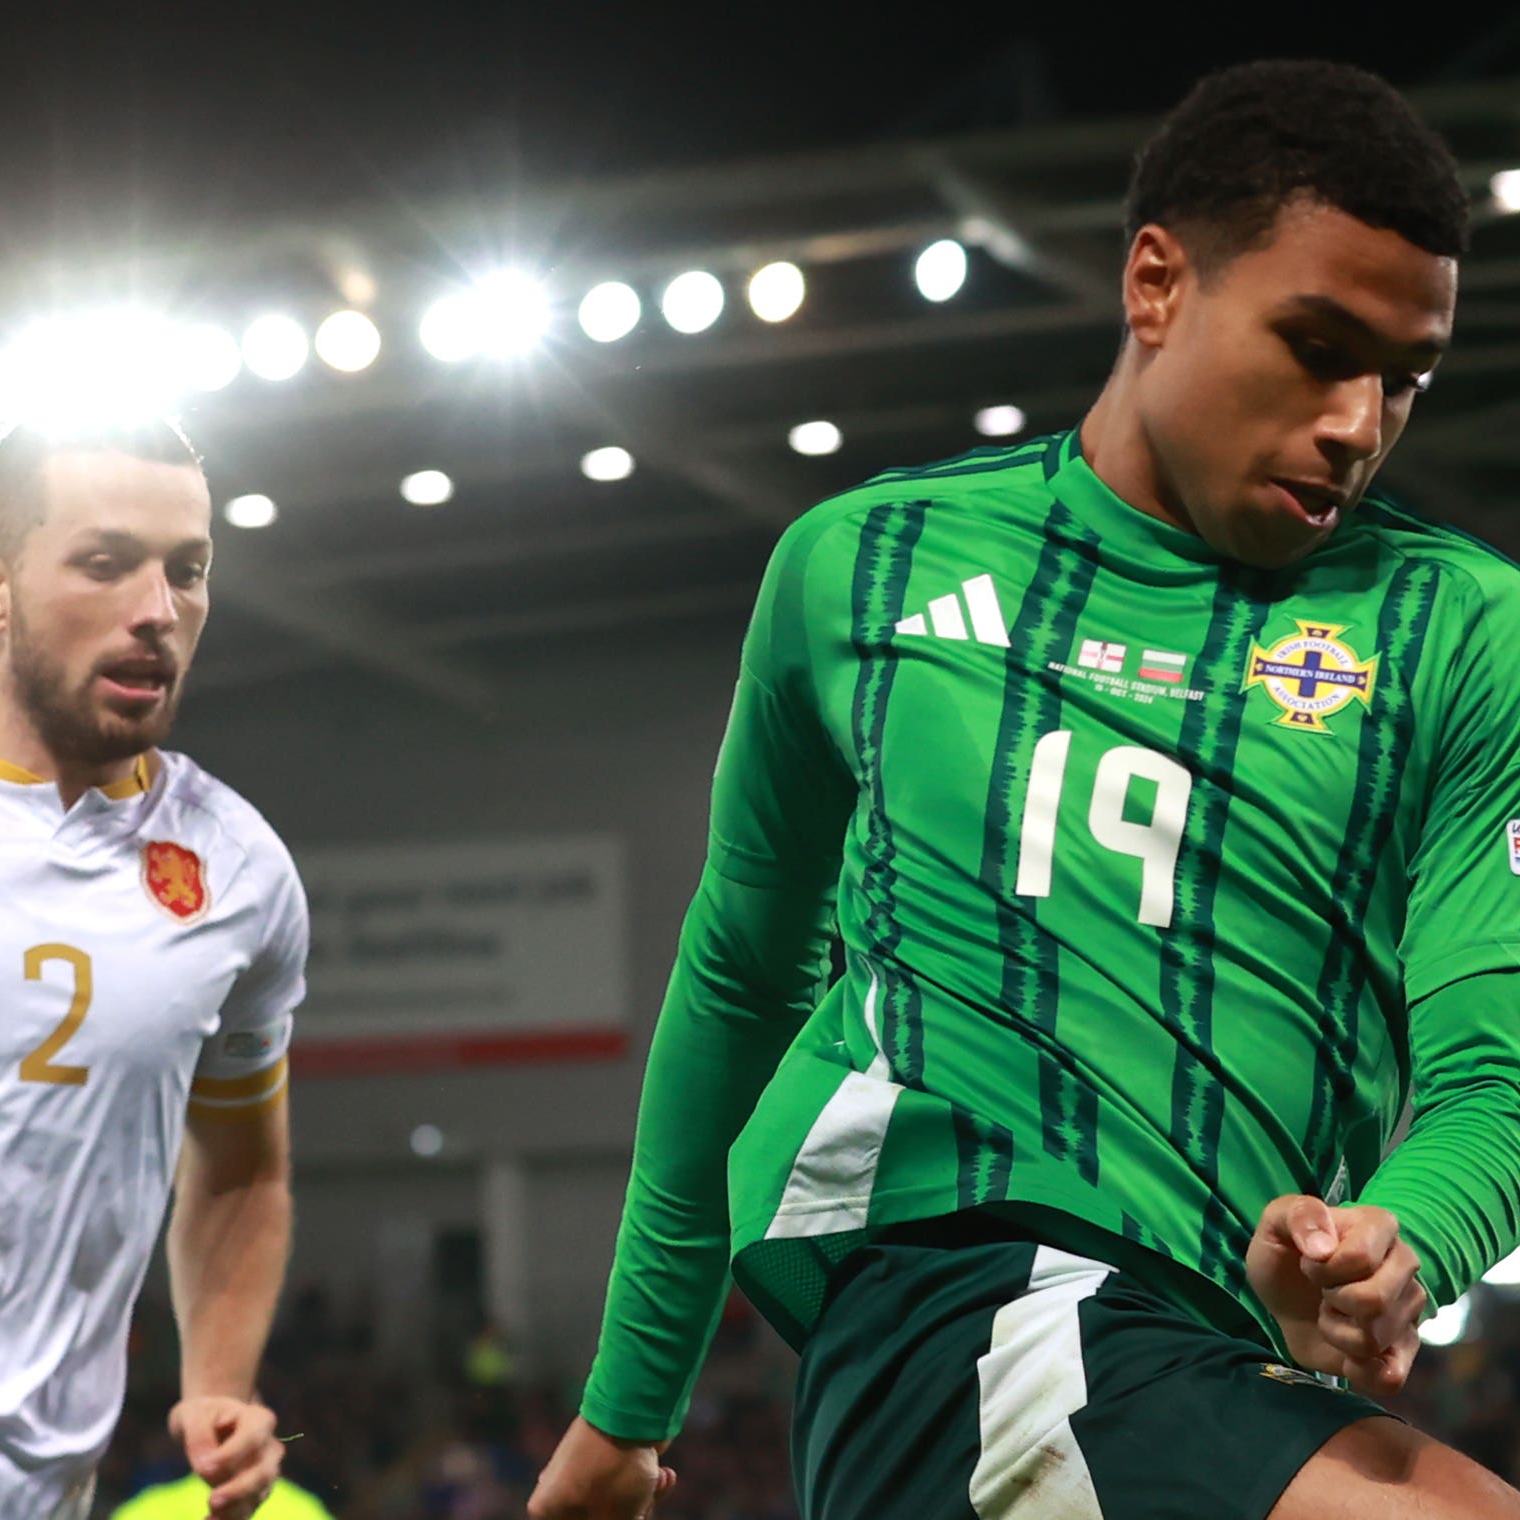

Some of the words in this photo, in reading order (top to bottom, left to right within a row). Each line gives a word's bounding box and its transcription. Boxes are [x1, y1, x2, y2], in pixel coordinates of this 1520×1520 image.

[1278, 641, 1302, 659] IRISH
[1303, 640, 1348, 666] FOOTBALL
[1047, 662, 1087, 679] NATIONAL
[1088, 672, 1129, 688] FOOTBALL
[1169, 688, 1205, 701] BELFAST
[1265, 664, 1313, 678] NORTHERN
[1314, 669, 1356, 683] IRELAND
[1274, 686, 1340, 709] ASSOCIATION
[1015, 730, 1193, 928] 19
[19, 941, 93, 1086] 2
